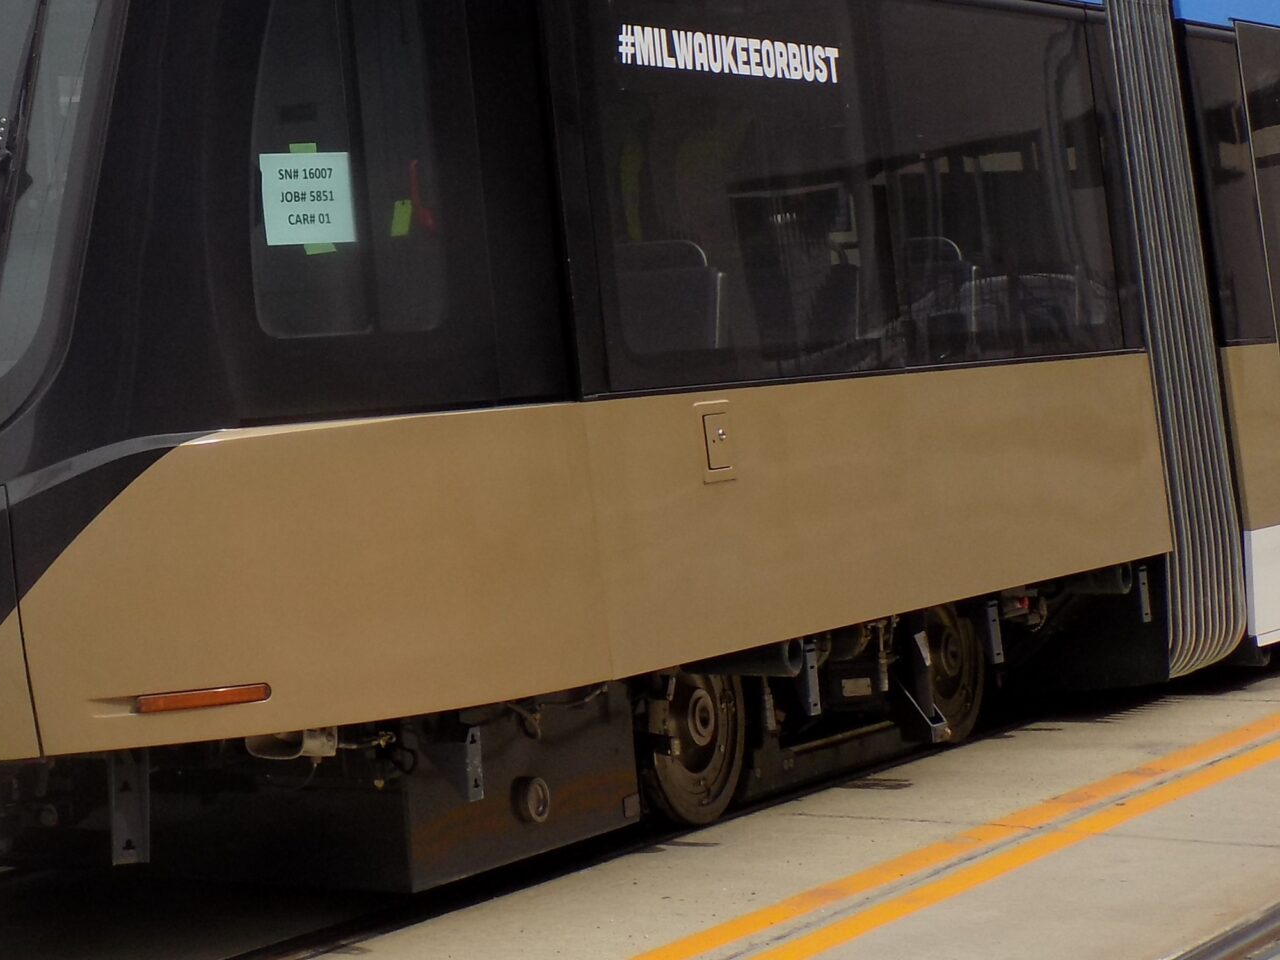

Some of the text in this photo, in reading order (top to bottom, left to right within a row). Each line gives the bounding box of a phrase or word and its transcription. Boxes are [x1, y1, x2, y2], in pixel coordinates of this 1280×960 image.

[618, 23, 840, 84] #MILWAUKEEORBUST
[277, 167, 333, 181] SN# 16007
[280, 190, 335, 203] JOB# 5851
[287, 212, 332, 225] CAR# 01
